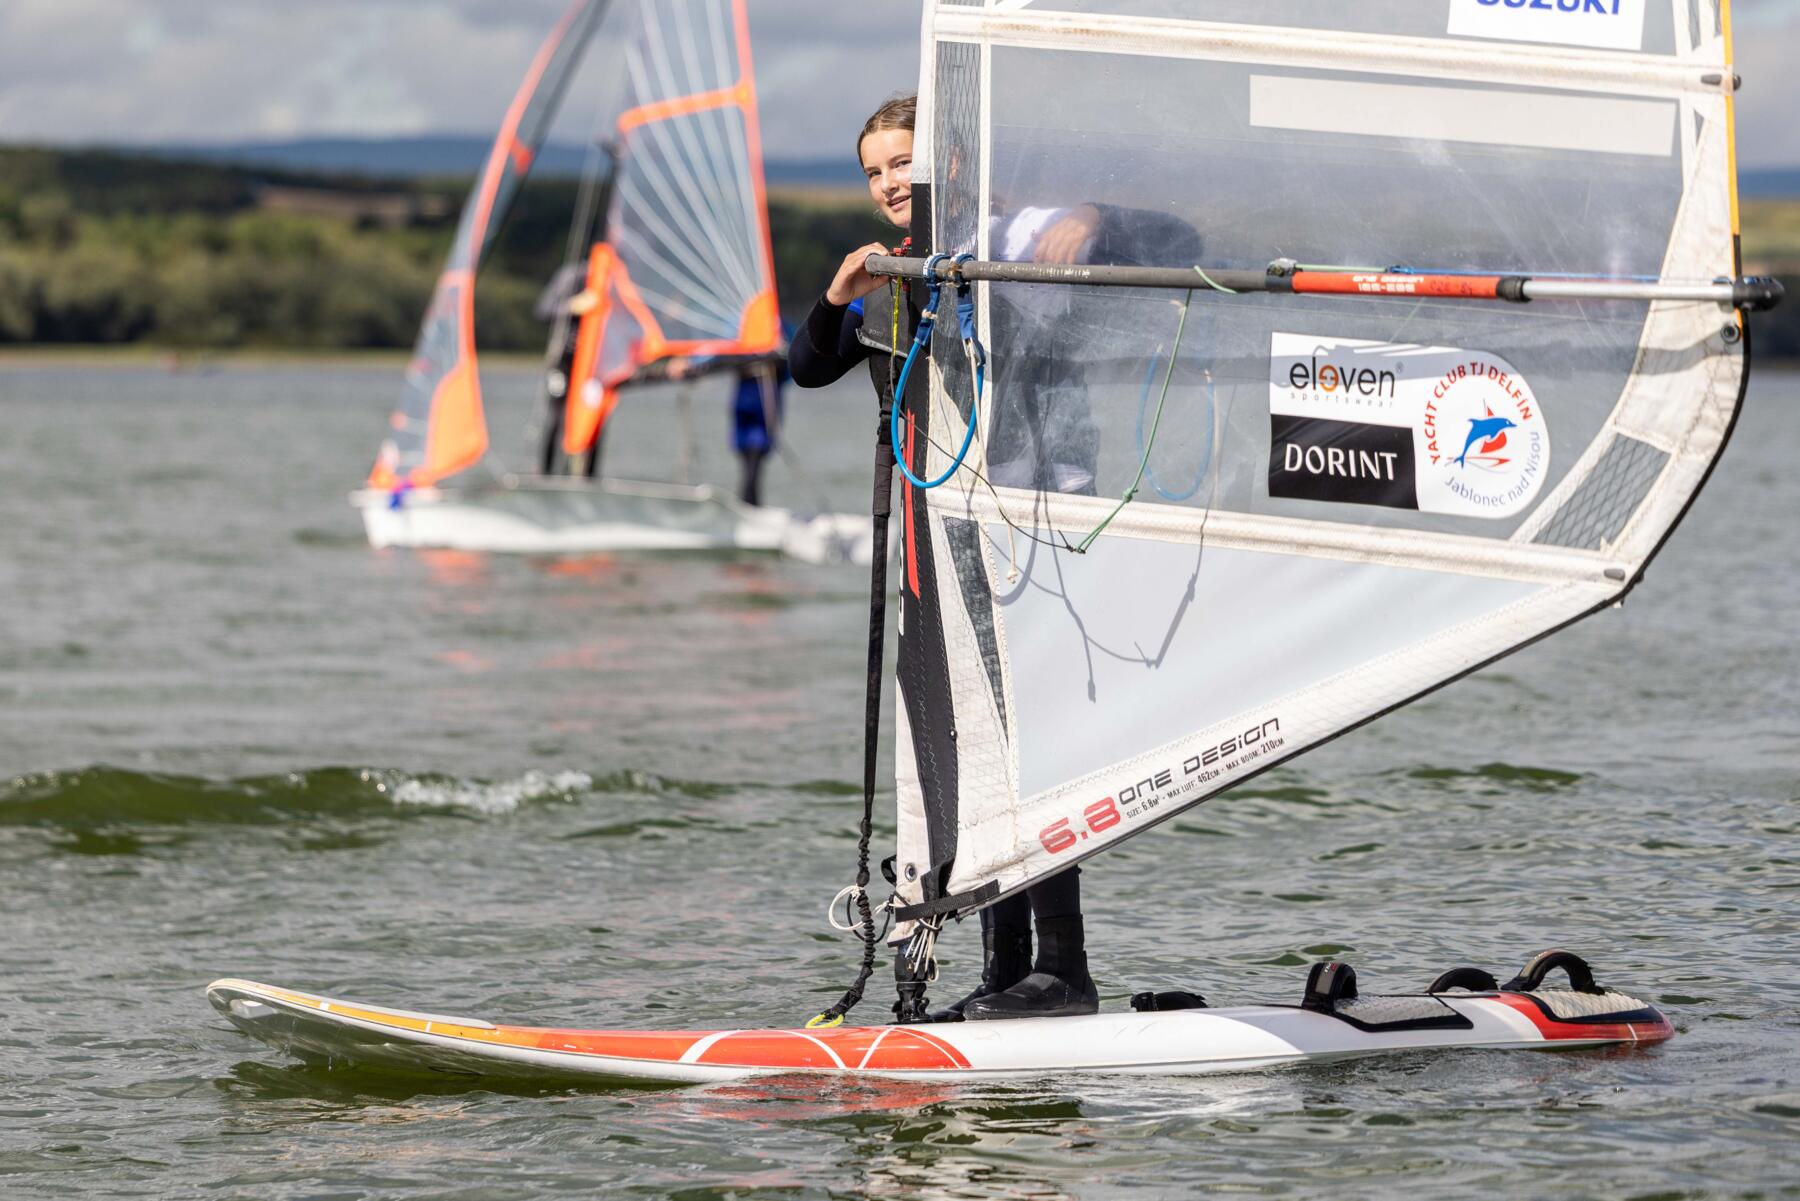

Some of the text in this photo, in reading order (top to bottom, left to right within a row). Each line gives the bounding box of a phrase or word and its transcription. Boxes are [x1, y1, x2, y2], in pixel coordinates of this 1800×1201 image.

[1476, 0, 1619, 15] UKI
[1424, 401, 1441, 465] YACHT
[1434, 364, 1466, 398] CLUB
[1470, 362, 1484, 376] TJ
[1284, 443, 1397, 480] DORINT
[1444, 431, 1541, 507] Jablonec nad Nisou
[1167, 787, 1181, 799] MAX
[1225, 757, 1240, 771] MAX
[1038, 796, 1121, 854] 6.8
